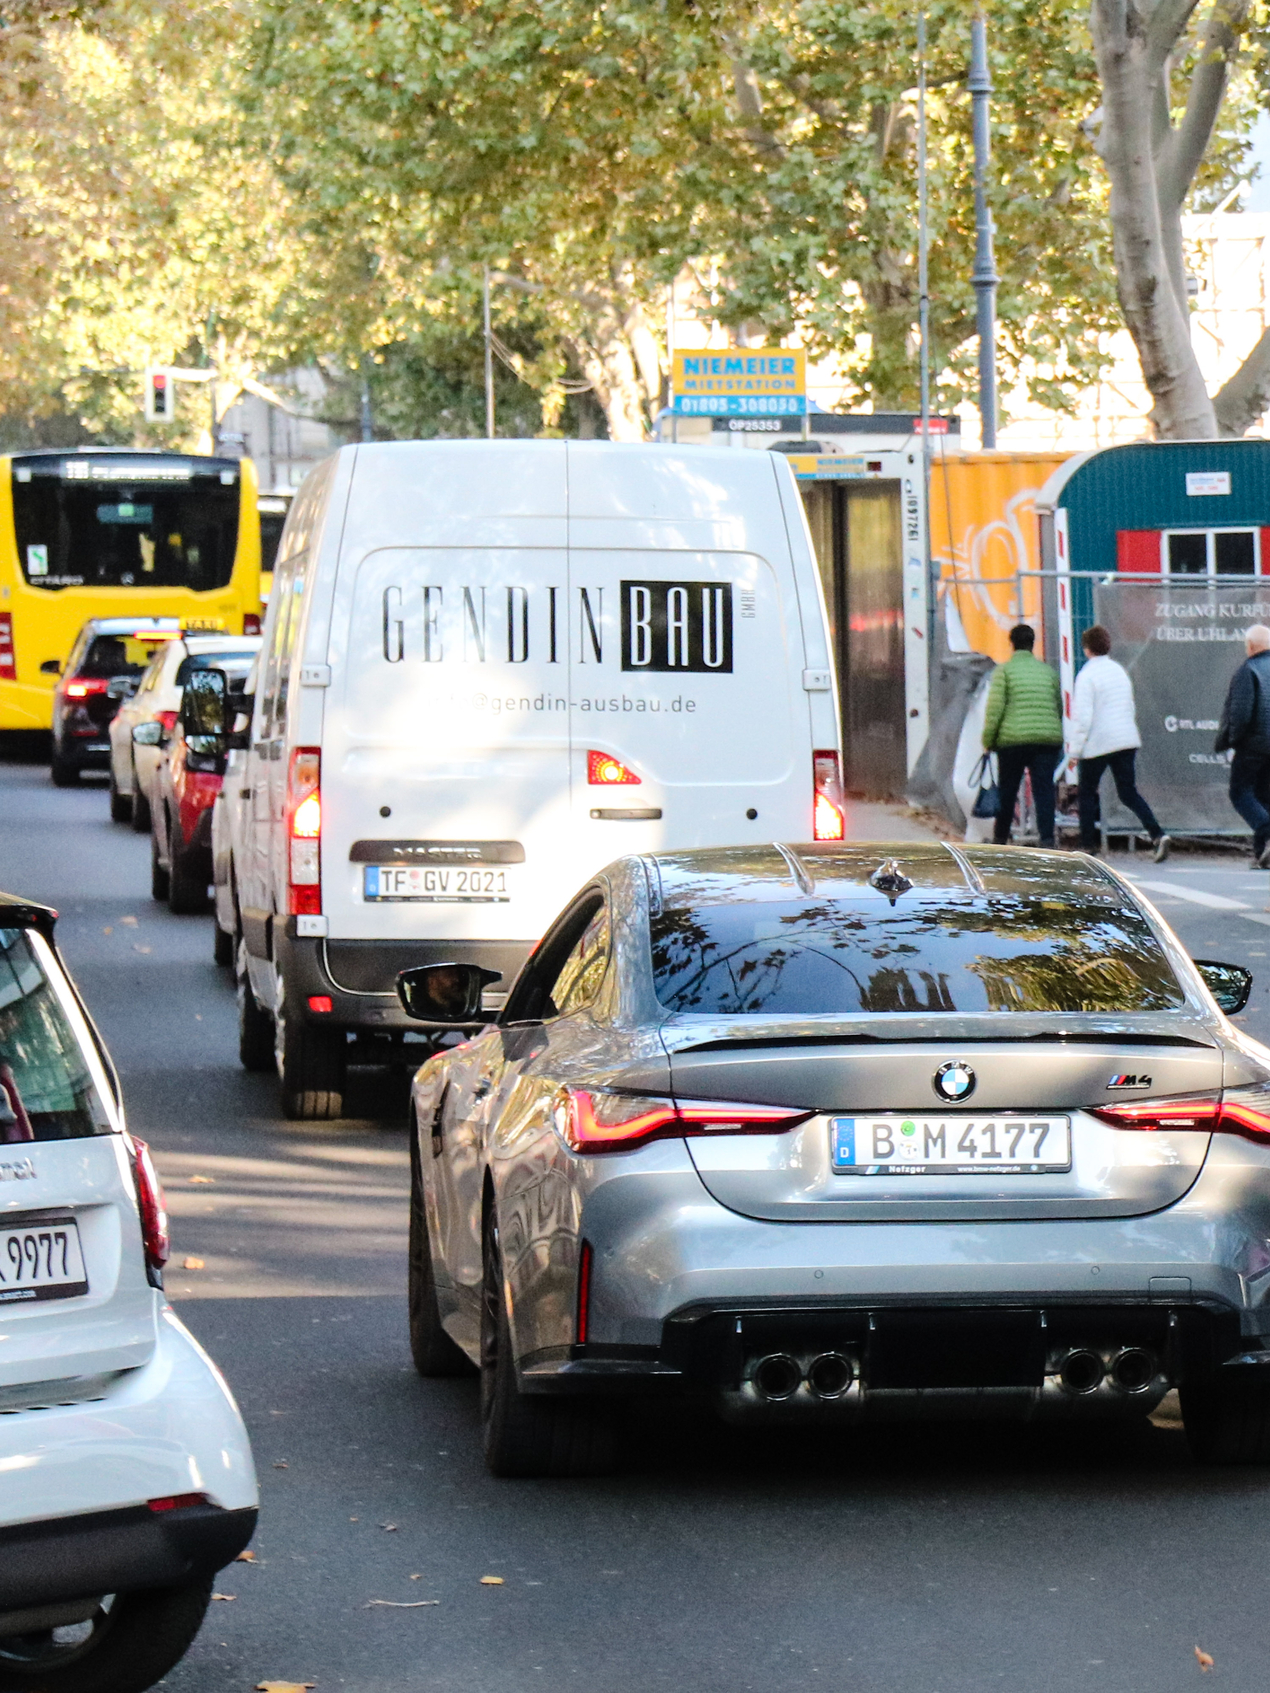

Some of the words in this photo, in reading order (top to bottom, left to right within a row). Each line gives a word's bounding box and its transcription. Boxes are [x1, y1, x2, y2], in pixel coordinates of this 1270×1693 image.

[683, 357, 796, 375] NIEMEIER
[684, 379, 796, 390] MIETSTATION
[681, 397, 798, 413] 01805-308050
[728, 419, 782, 431] OP25353
[1155, 602, 1216, 618] ZUGANG
[382, 585, 604, 665] GENDIN
[629, 586, 724, 668] BAU
[1157, 627, 1195, 642] ÜBER
[428, 692, 697, 715] @gendin-ausbau.de
[381, 870, 407, 892] TF
[424, 871, 450, 892] GV
[457, 872, 507, 893] 2021
[840, 1146, 849, 1158] D
[872, 1123, 896, 1160] B
[923, 1123, 947, 1159] M
[957, 1122, 1051, 1159] 4177
[8, 1231, 68, 1281] 9977
